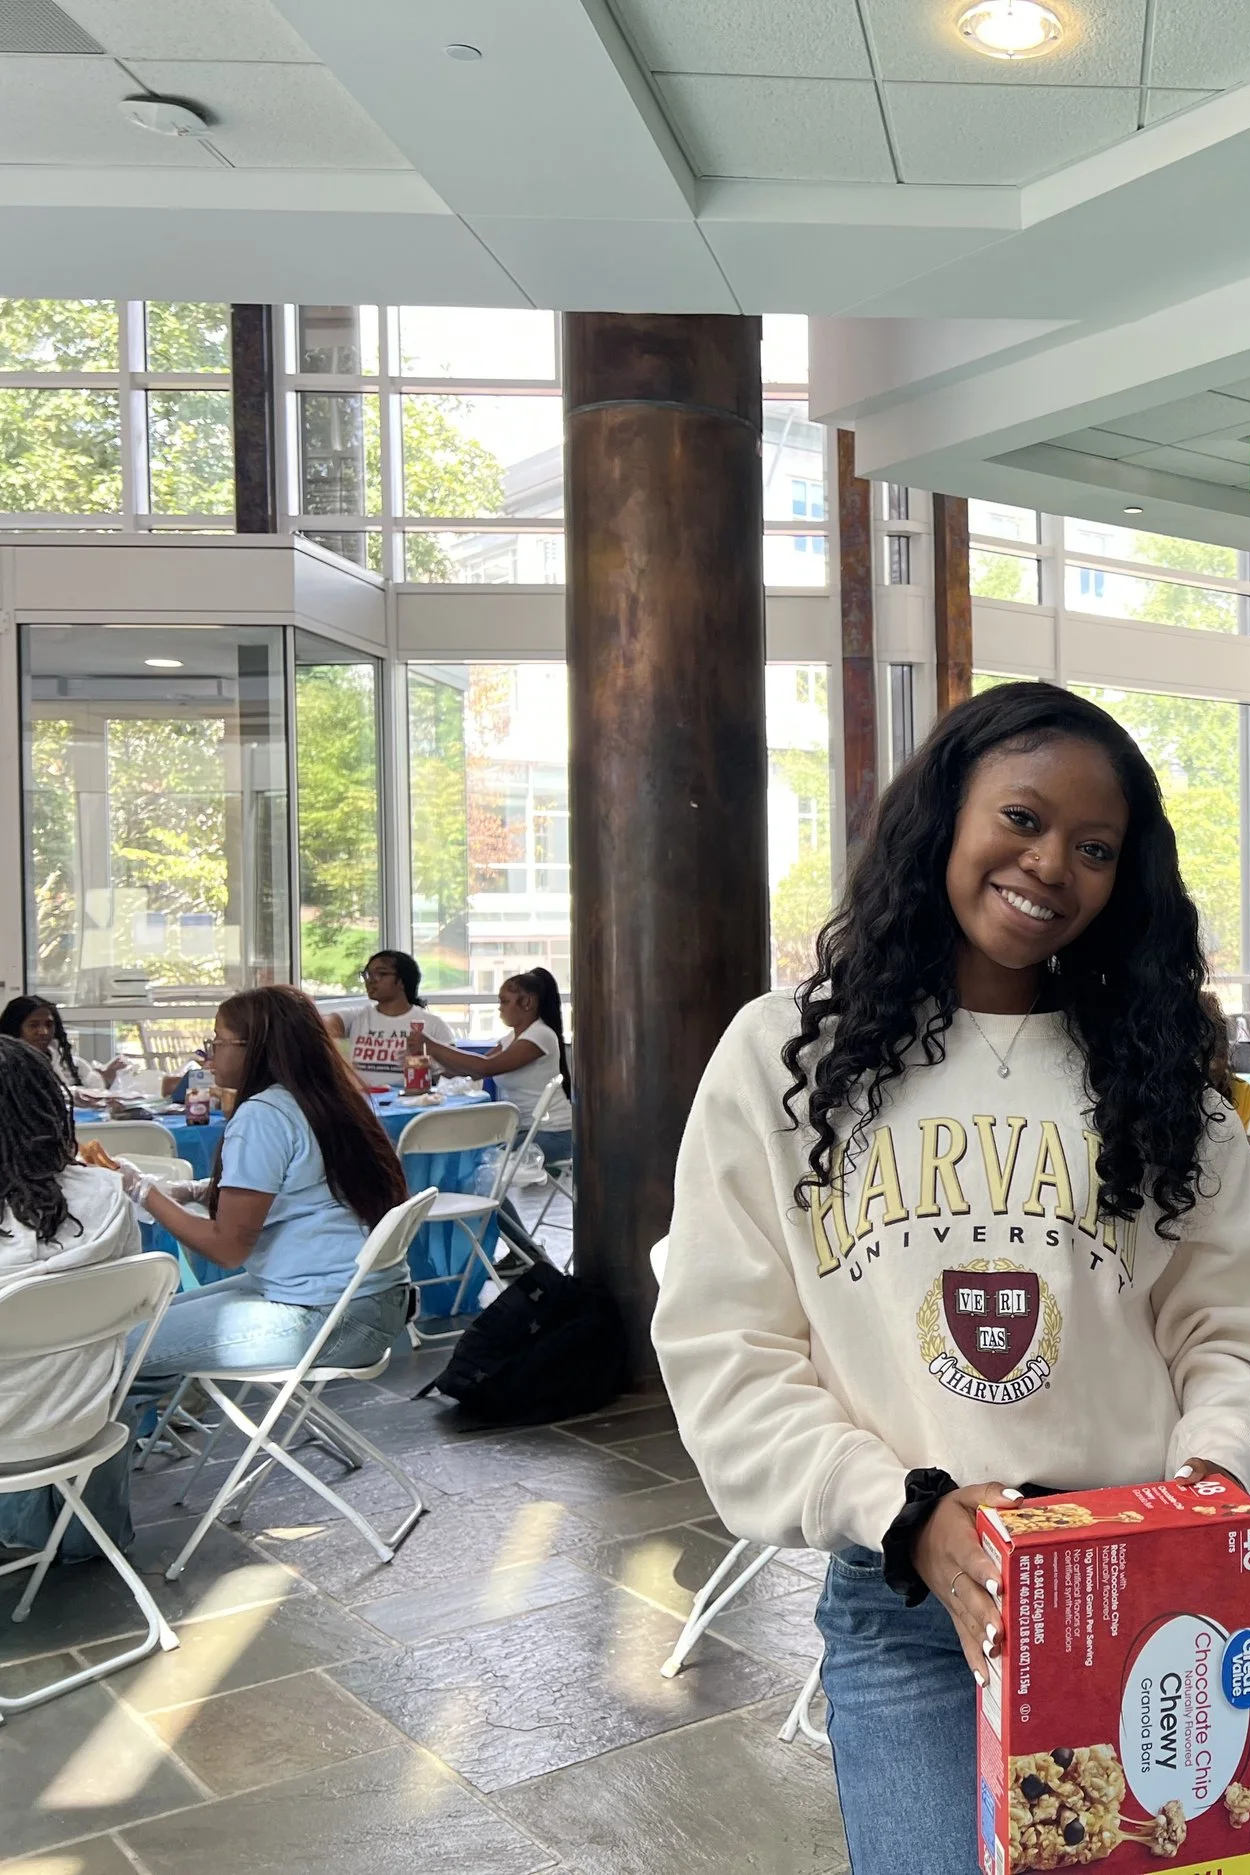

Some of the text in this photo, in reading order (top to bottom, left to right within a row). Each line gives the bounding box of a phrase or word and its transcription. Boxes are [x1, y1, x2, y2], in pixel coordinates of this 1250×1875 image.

[355, 1035, 405, 1048] PANTH
[369, 1029, 407, 1038] WE AR
[810, 1114, 1139, 1282] HARVA
[960, 1292, 1022, 1311] VE RI
[980, 1331, 1005, 1347] TAS
[947, 1369, 1034, 1401] HARVARD
[1193, 1481, 1226, 1496] 48
[1034, 1554, 1044, 1564] 48
[1073, 1549, 1081, 1562] No
[1034, 1569, 1044, 1588] 0.84
[1102, 1546, 1110, 1620] Naturally flavored
[1111, 1565, 1119, 1610] Chocolate
[1119, 1572, 1127, 1590] with
[1034, 1588, 1044, 1600] OZ
[1064, 1550, 1073, 1652] certified synthetic colors
[1032, 1600, 1044, 1622] (24g)
[1084, 1548, 1094, 1666] 10g Whole Grain Per Serving
[1018, 1555, 1030, 1694] NET WT 40.6 OZ (2 LB 8.6 OZ) 1.15kg
[1034, 1622, 1044, 1644] BARS
[1074, 1628, 1080, 1637] or
[1110, 1612, 1119, 1636] Chips
[1232, 1654, 1243, 1696] Value
[1141, 1678, 1152, 1773] Granola Bars
[1155, 1672, 1182, 1770] Chewy
[1184, 1670, 1193, 1767] Naturally Flavored
[1192, 1632, 1211, 1800] Chocolate Chip
